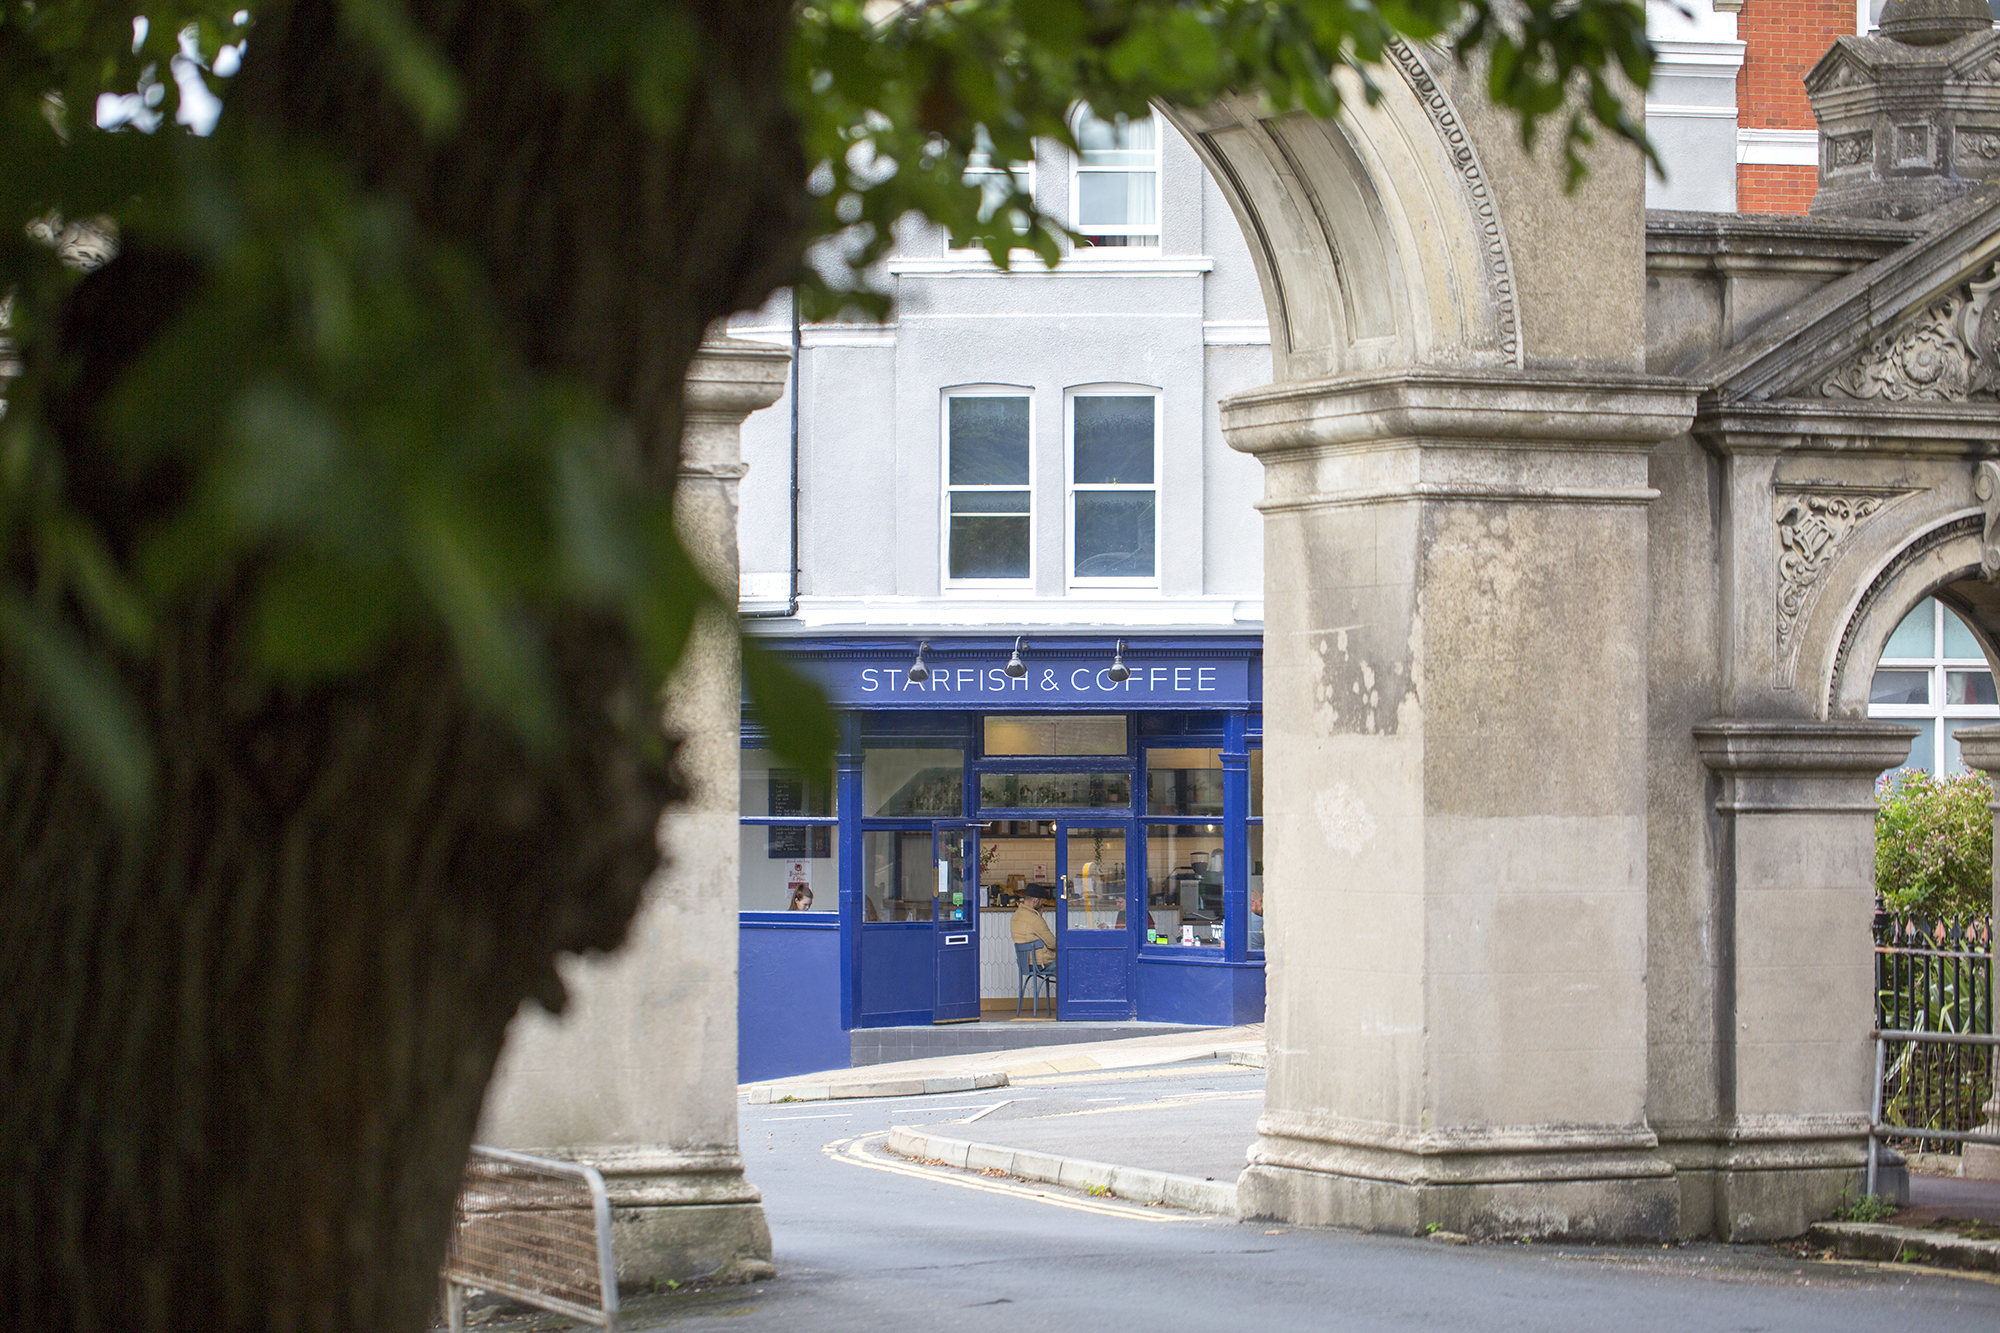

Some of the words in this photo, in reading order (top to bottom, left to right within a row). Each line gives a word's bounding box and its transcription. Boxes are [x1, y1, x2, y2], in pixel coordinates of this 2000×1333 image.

[861, 668, 1029, 692] STARFISH
[1040, 668, 1060, 691] &
[1070, 667, 1216, 692] COFFEE
